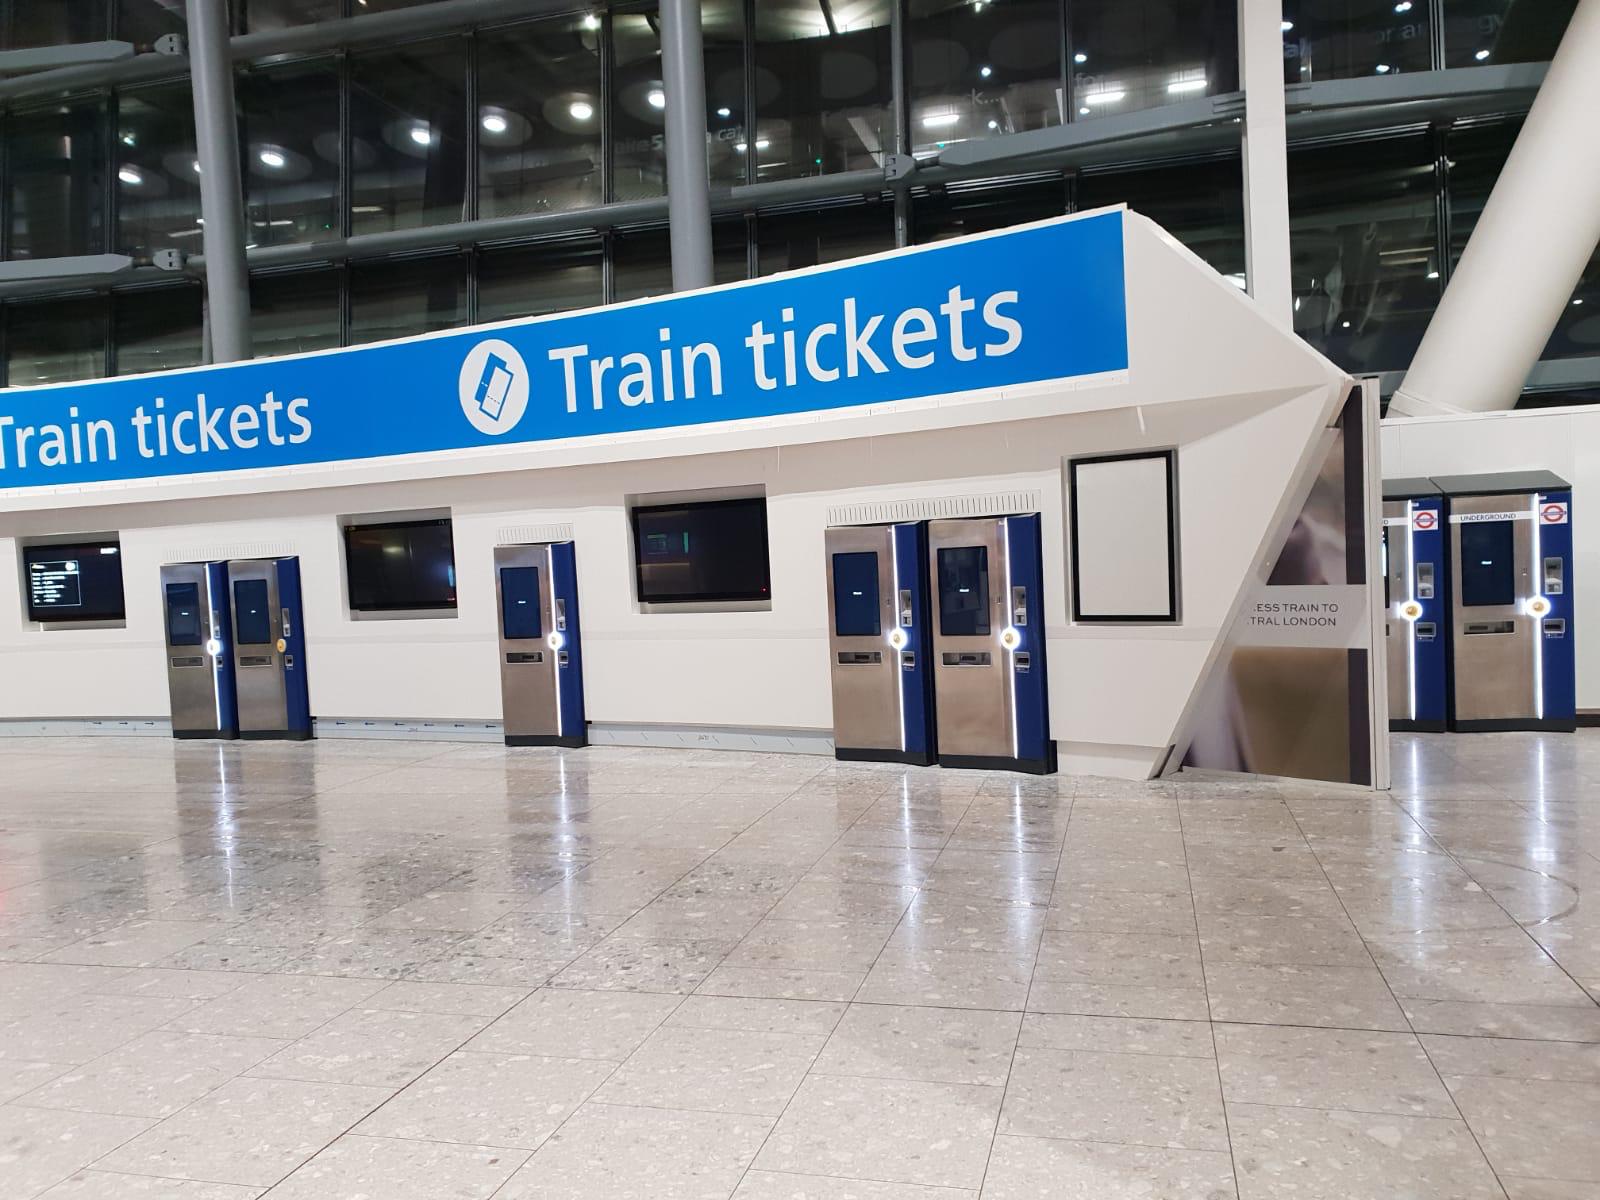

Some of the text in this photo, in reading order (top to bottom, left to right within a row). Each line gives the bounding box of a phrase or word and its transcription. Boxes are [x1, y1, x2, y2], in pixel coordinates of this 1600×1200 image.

[548, 285, 1023, 413] Train tickets
[131, 391, 312, 458] tickets
[1460, 513, 1517, 522] UNDERGROUND
[1254, 603, 1339, 613] ESS TRAIN TO
[1248, 616, 1336, 627] TRAL LONDON
